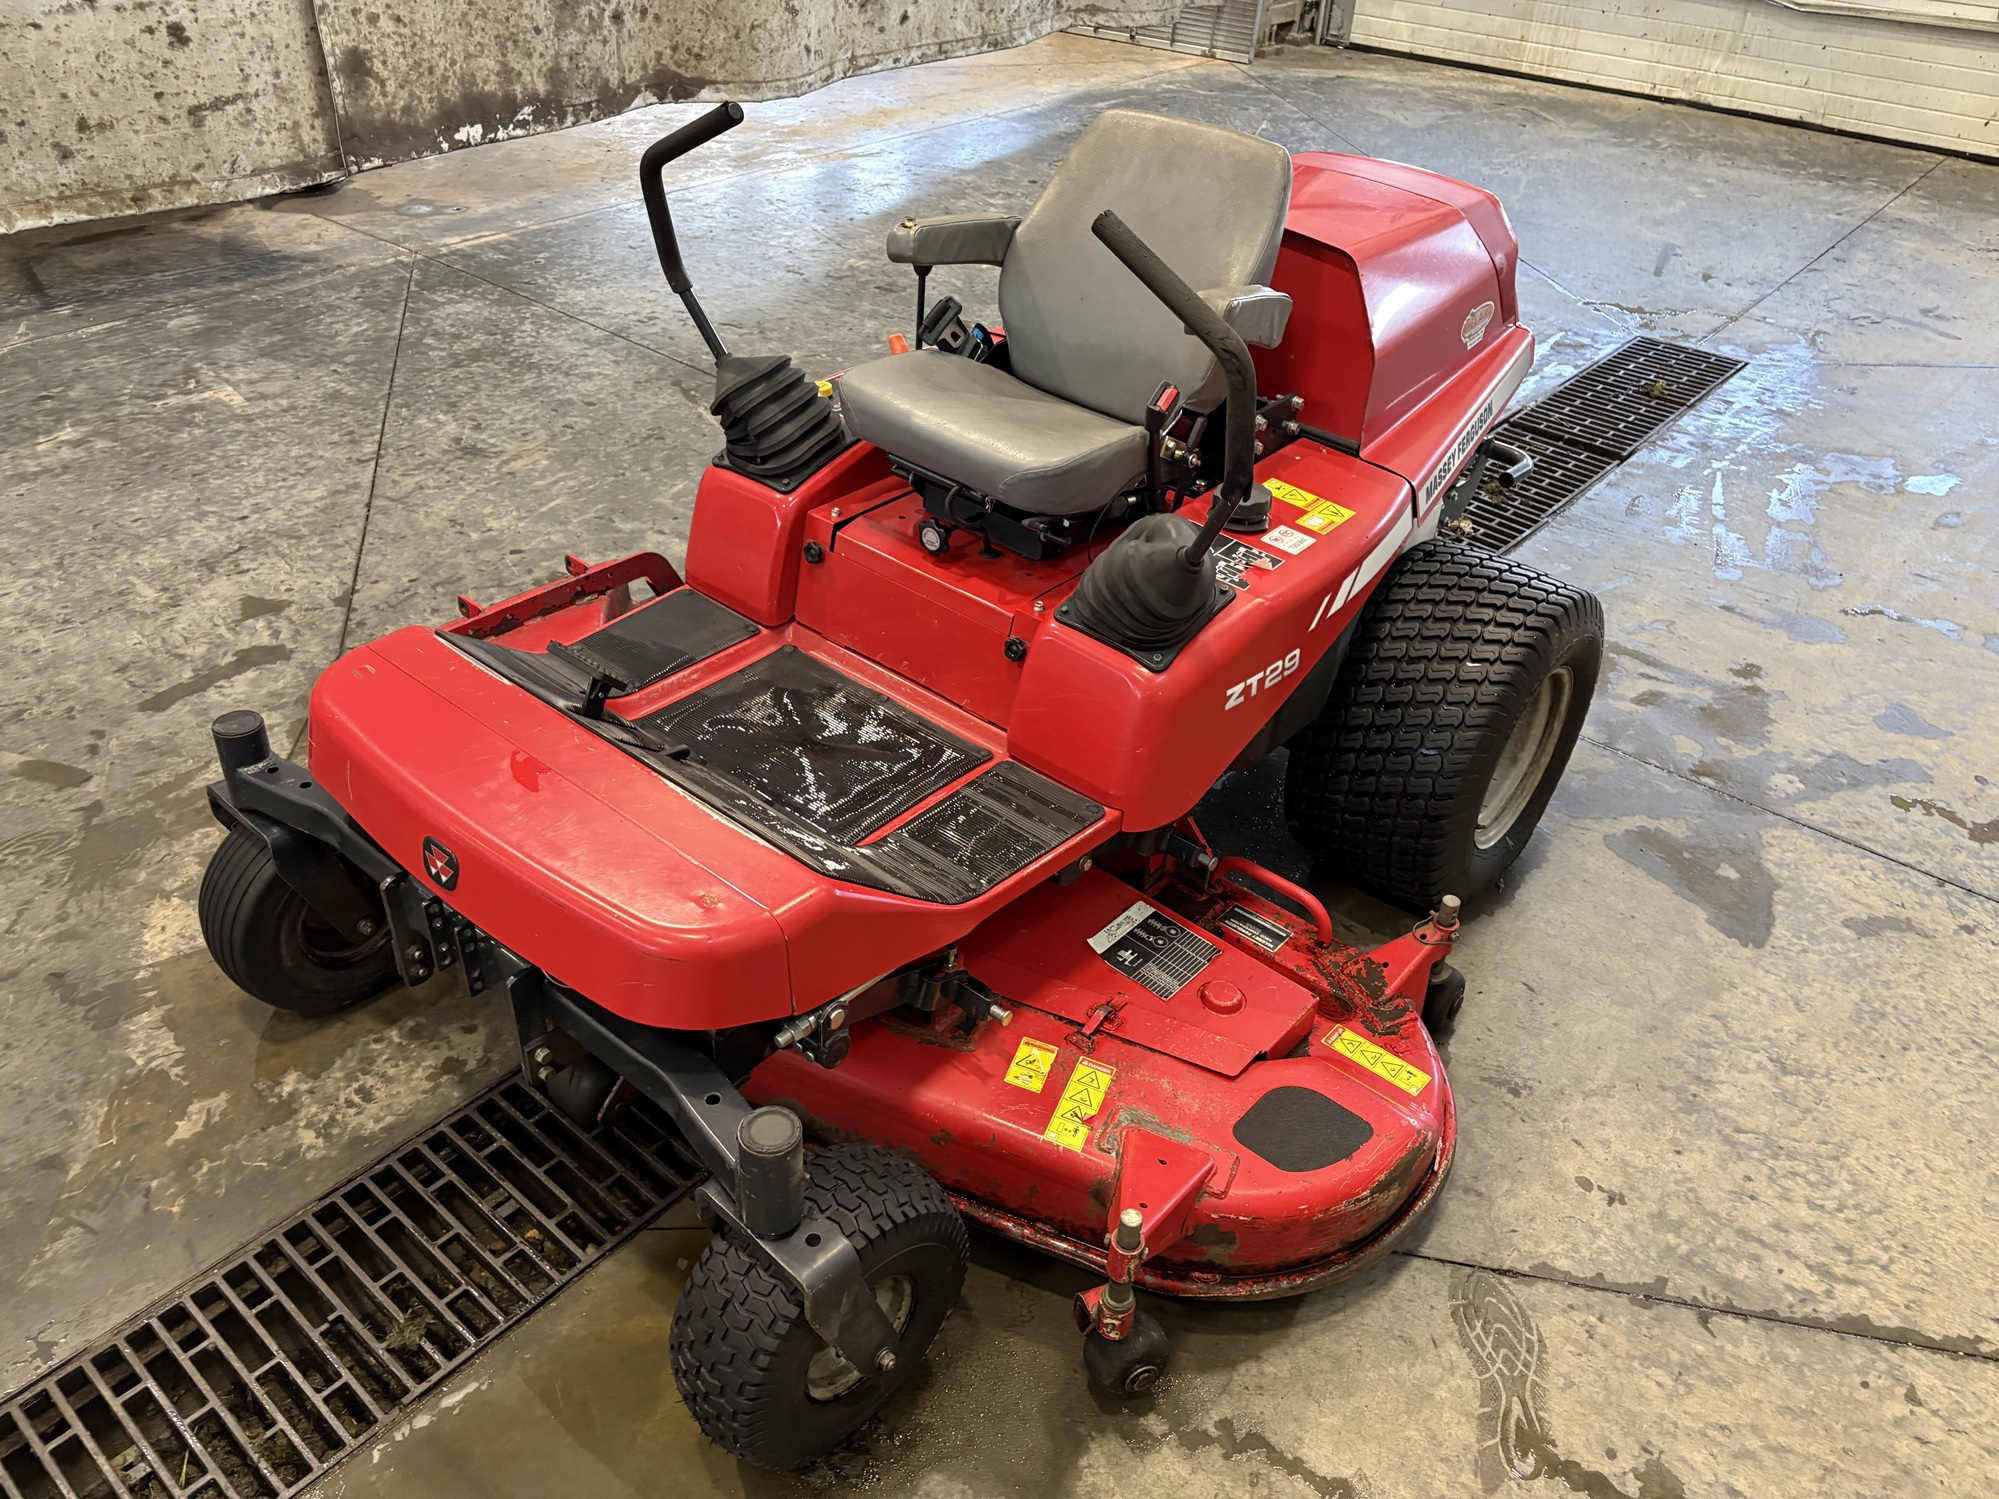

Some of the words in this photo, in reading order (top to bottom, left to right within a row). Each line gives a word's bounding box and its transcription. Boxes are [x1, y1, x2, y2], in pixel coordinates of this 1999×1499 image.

[1425, 448, 1457, 504] MASSEY
[1457, 400, 1494, 460] FERGUSON
[1224, 647, 1301, 711] ZT29
[1225, 919, 1252, 936] FERGUSON
[1251, 935, 1274, 949] MASSEY
[1087, 1061, 1112, 1074] DANGER
